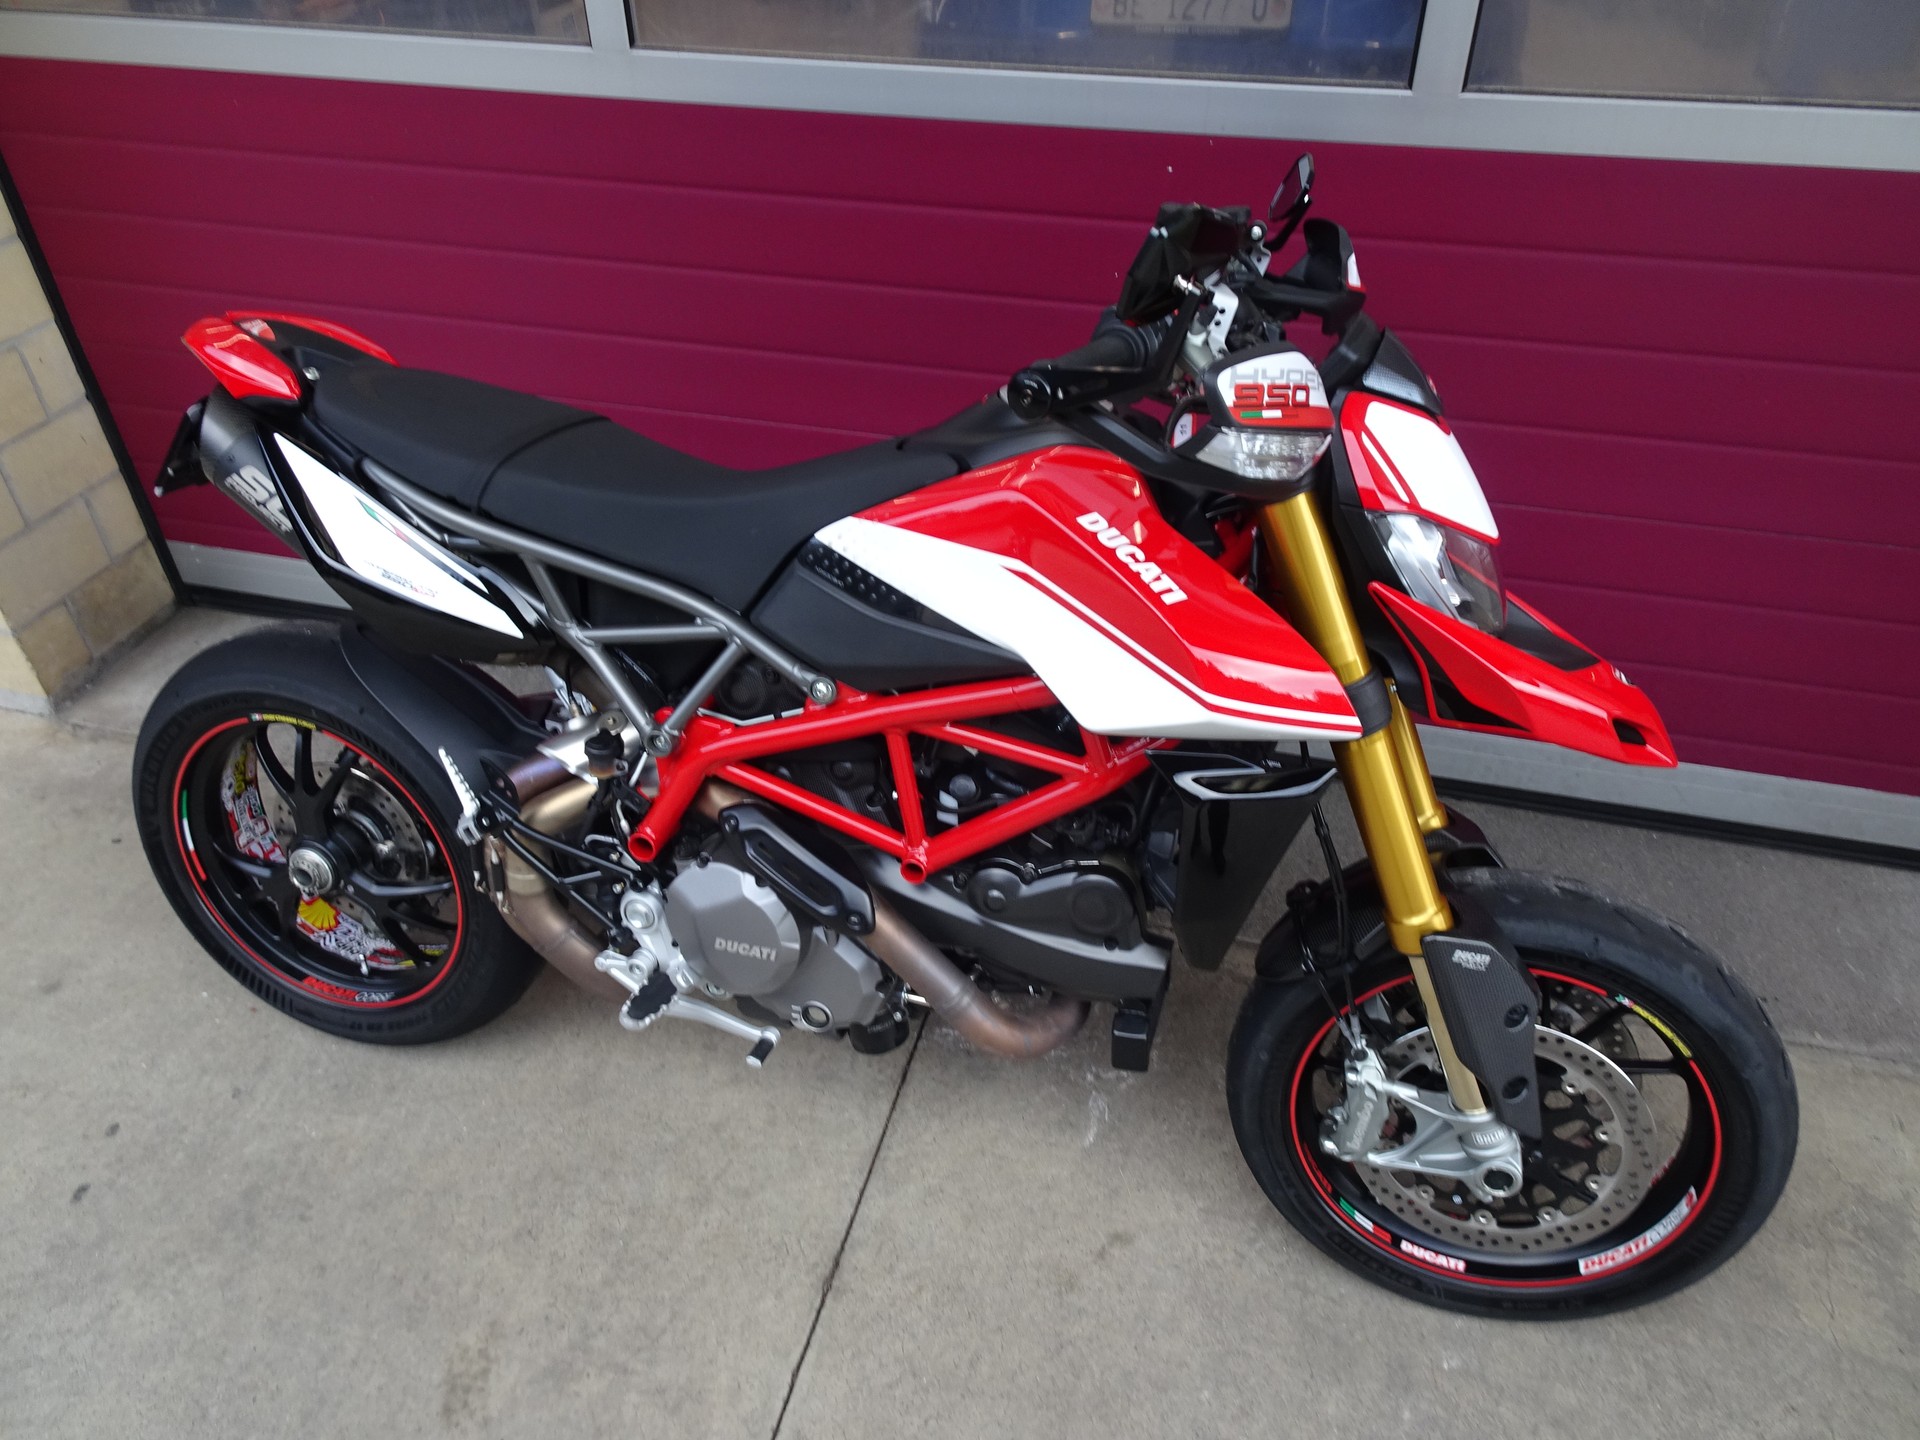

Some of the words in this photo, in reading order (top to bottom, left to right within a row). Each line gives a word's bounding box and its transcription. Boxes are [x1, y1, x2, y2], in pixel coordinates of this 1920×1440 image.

[1232, 383, 1311, 407] 950
[1075, 511, 1189, 606] DUCATI
[714, 937, 777, 962] DUCATI
[1347, 1101, 1375, 1152] brembo
[1401, 1239, 1467, 1274] DUCATI
